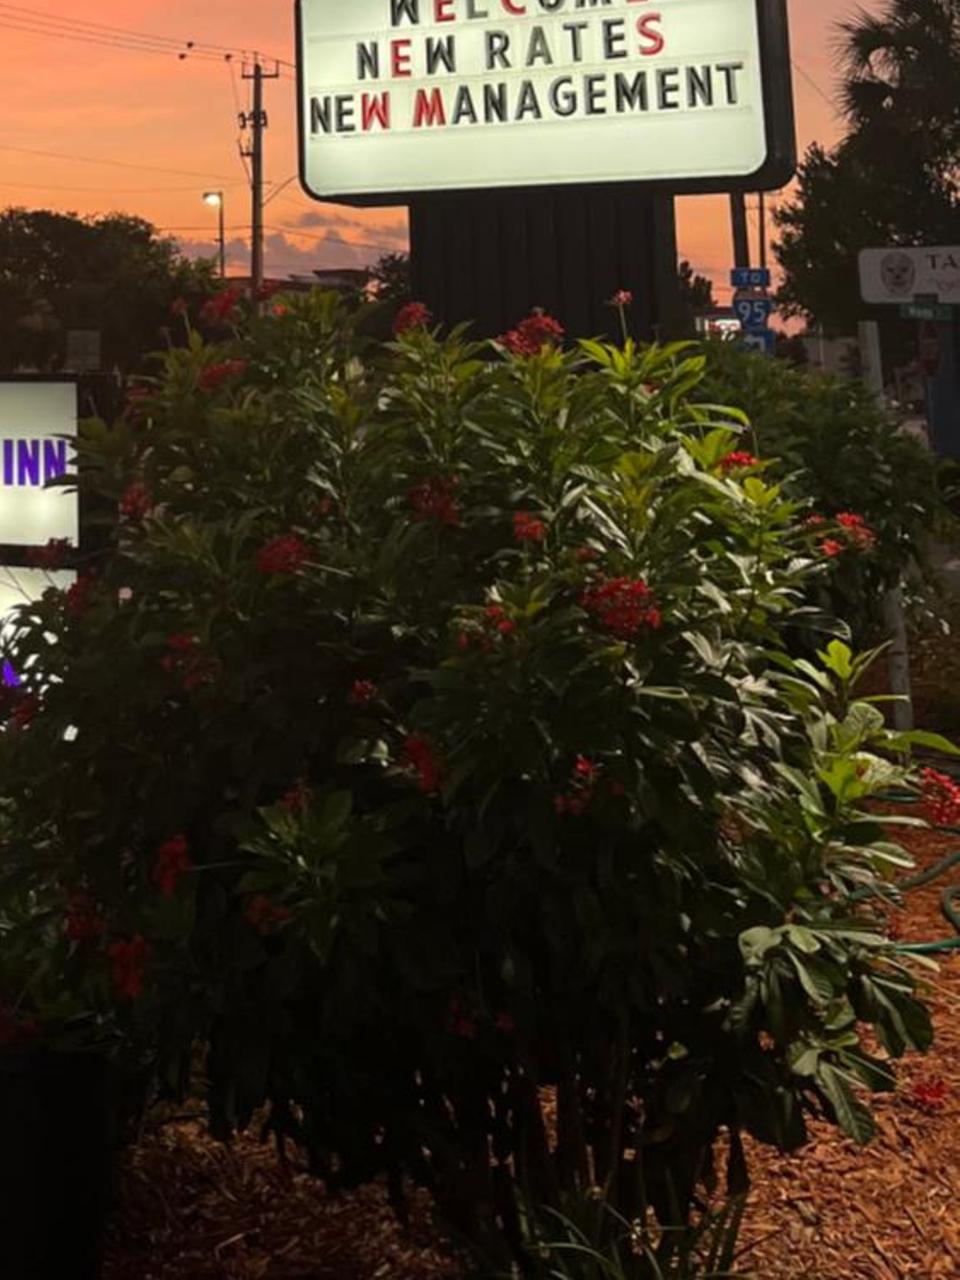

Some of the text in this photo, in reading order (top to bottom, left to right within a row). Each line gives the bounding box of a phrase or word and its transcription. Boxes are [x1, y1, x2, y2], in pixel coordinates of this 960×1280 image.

[356, 12, 665, 80] NEW RATES
[309, 61, 744, 135] NEW MANAGEMENT
[738, 301, 767, 323] 95
[2, 439, 67, 487] INN
